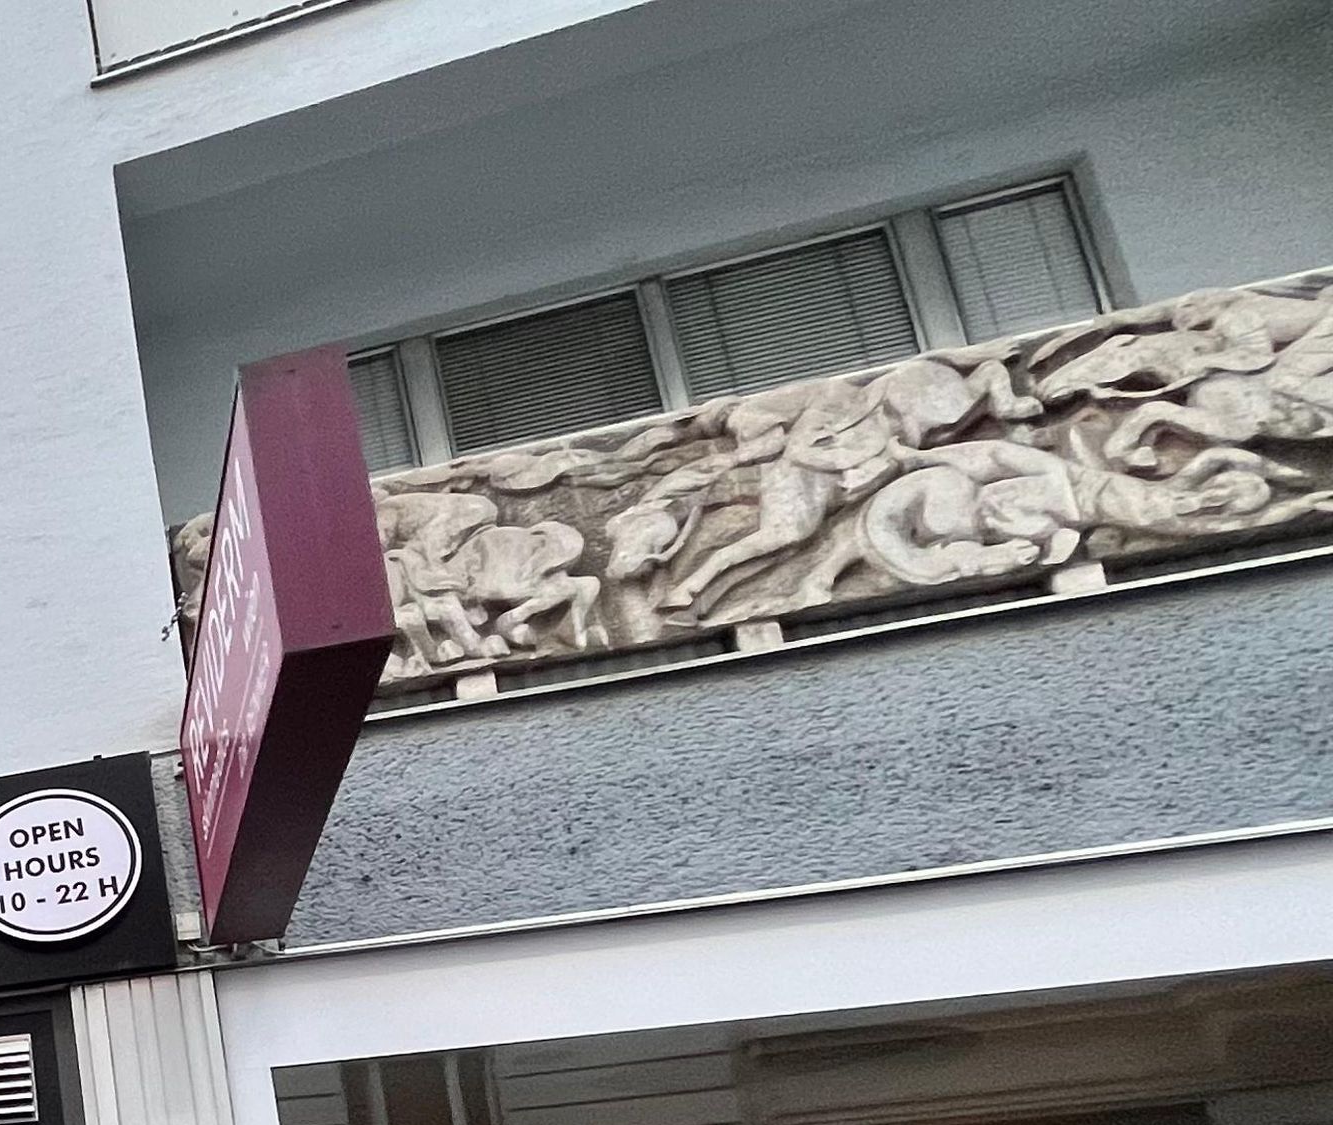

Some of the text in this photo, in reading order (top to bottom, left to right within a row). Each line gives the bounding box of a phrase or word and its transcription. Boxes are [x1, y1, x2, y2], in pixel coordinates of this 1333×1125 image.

[9, 818, 84, 848] OPEN
[4, 847, 101, 881] HOURS
[55, 881, 89, 905] 22
[98, 876, 119, 897] H
